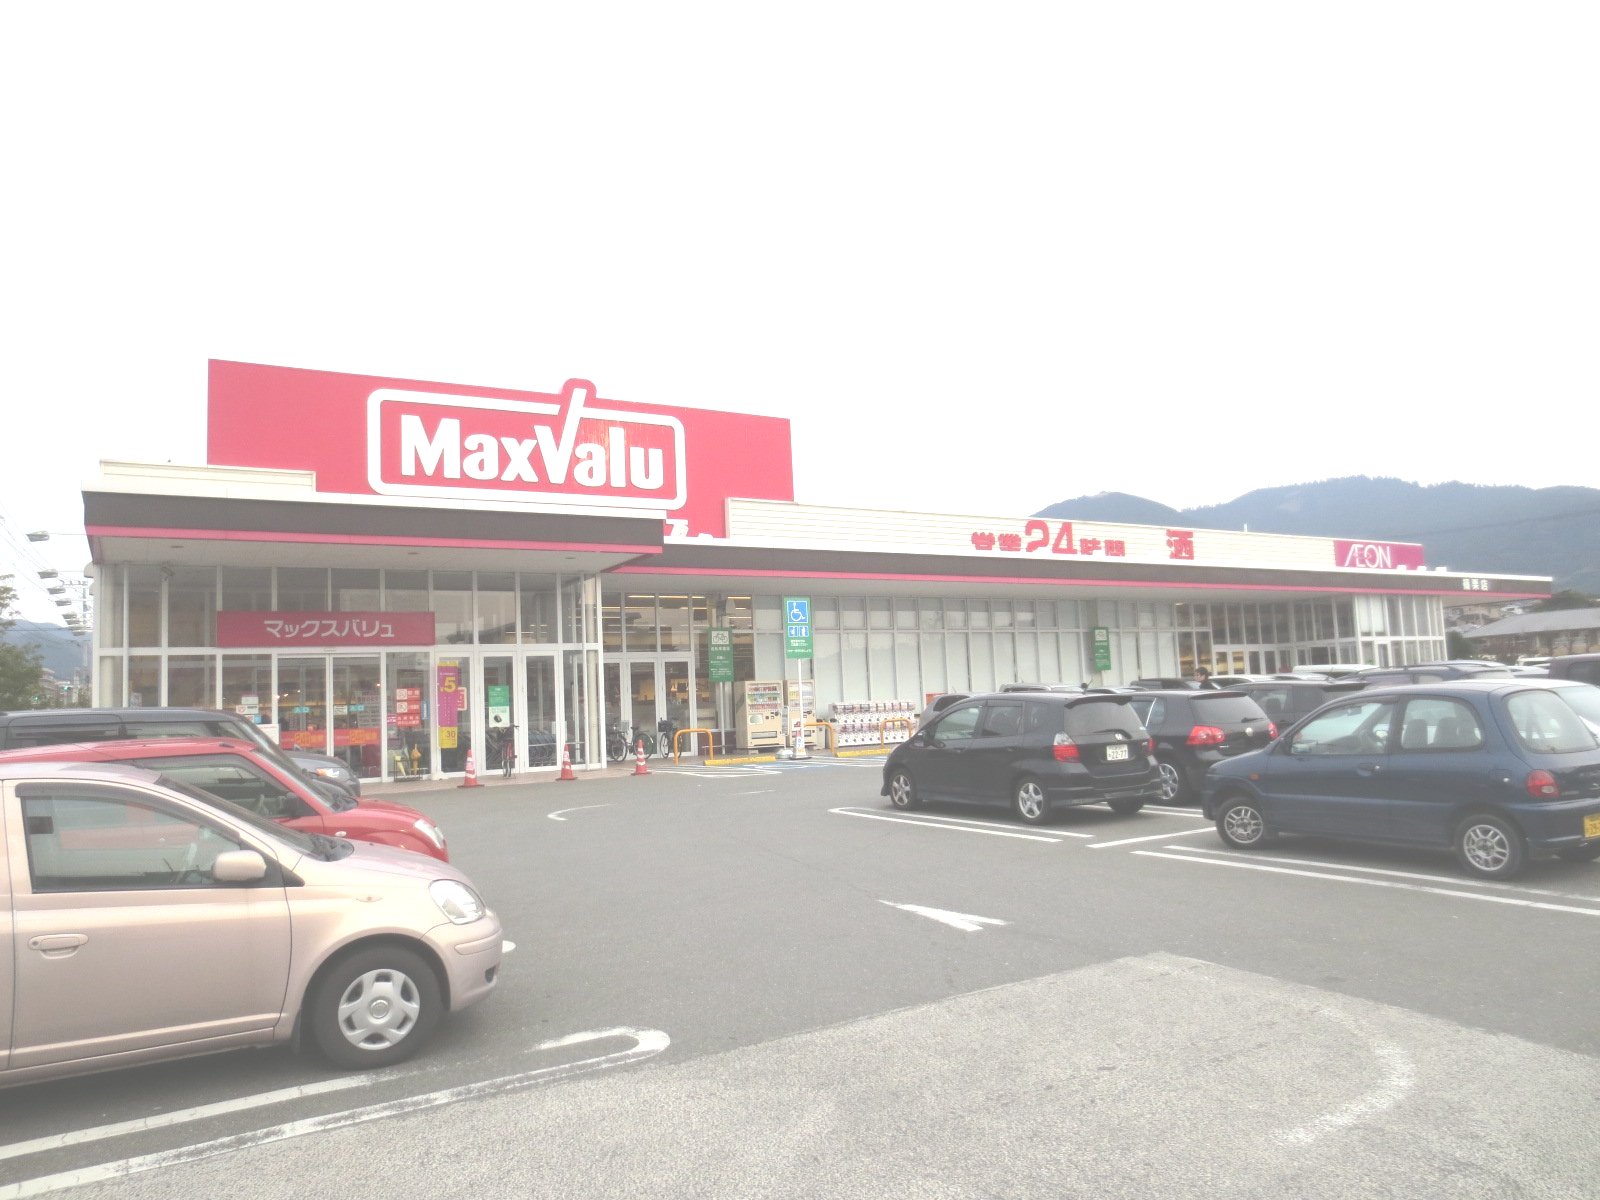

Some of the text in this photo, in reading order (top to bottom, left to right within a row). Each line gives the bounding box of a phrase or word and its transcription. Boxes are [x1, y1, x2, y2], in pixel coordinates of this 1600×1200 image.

[400, 387, 664, 490] MaxValu
[1165, 528, 1195, 560] 酒
[264, 619, 395, 638] マックスバリュ
